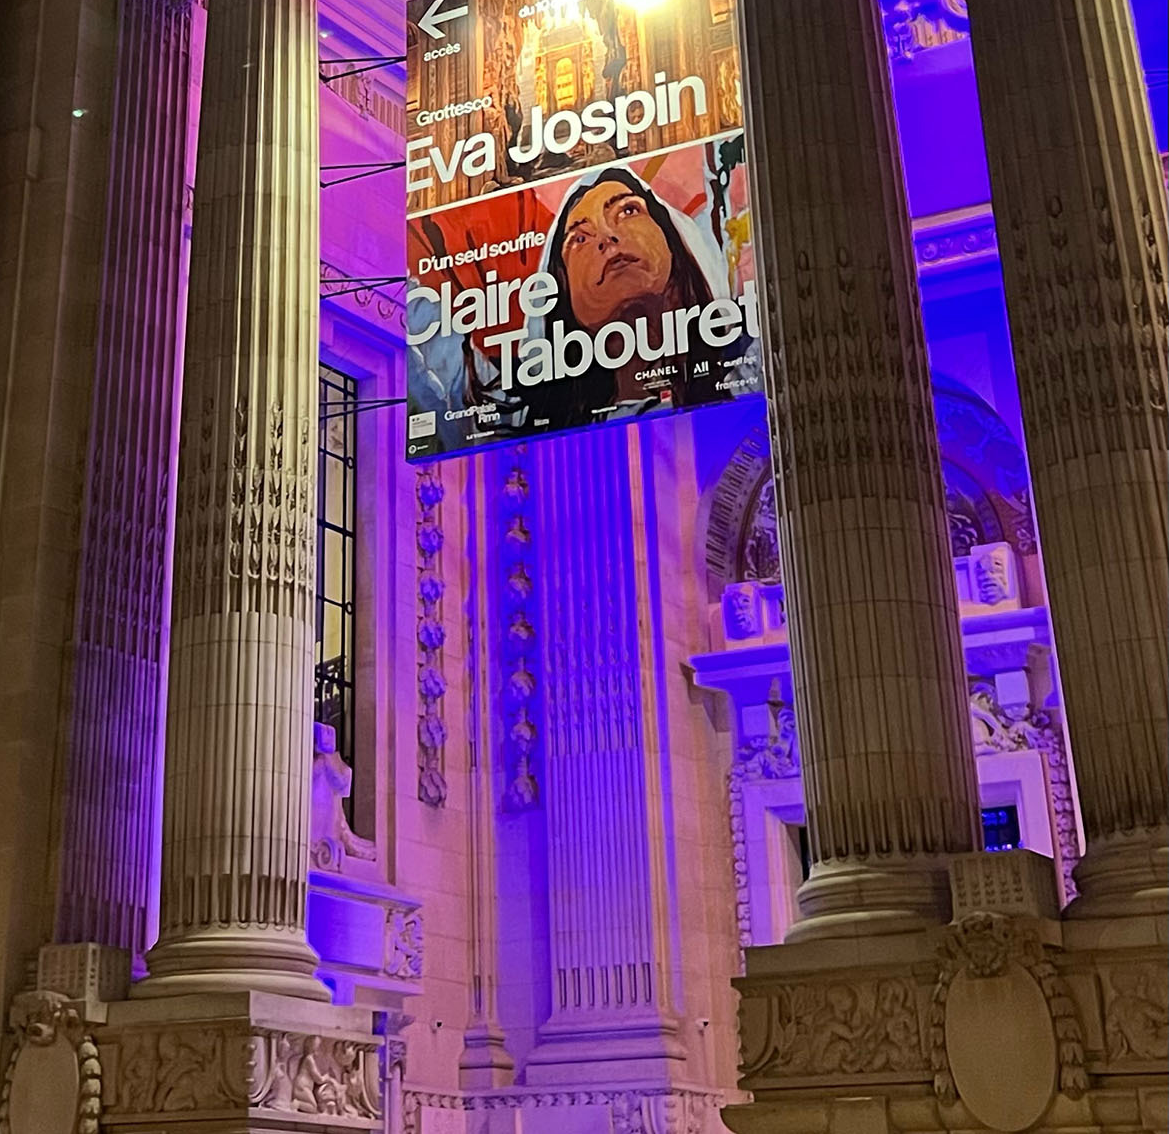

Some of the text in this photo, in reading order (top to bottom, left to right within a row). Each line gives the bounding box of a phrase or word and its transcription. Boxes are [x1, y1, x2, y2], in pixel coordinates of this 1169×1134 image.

[424, 43, 461, 62] accès
[416, 96, 492, 126] Grottesco
[406, 71, 707, 193] Eva Jospin
[418, 230, 545, 275] D'un seul souffle
[406, 270, 559, 346] Claire
[483, 280, 760, 391] Tabouret
[634, 365, 678, 381] CHANEL
[444, 403, 497, 421] GrandPalais
